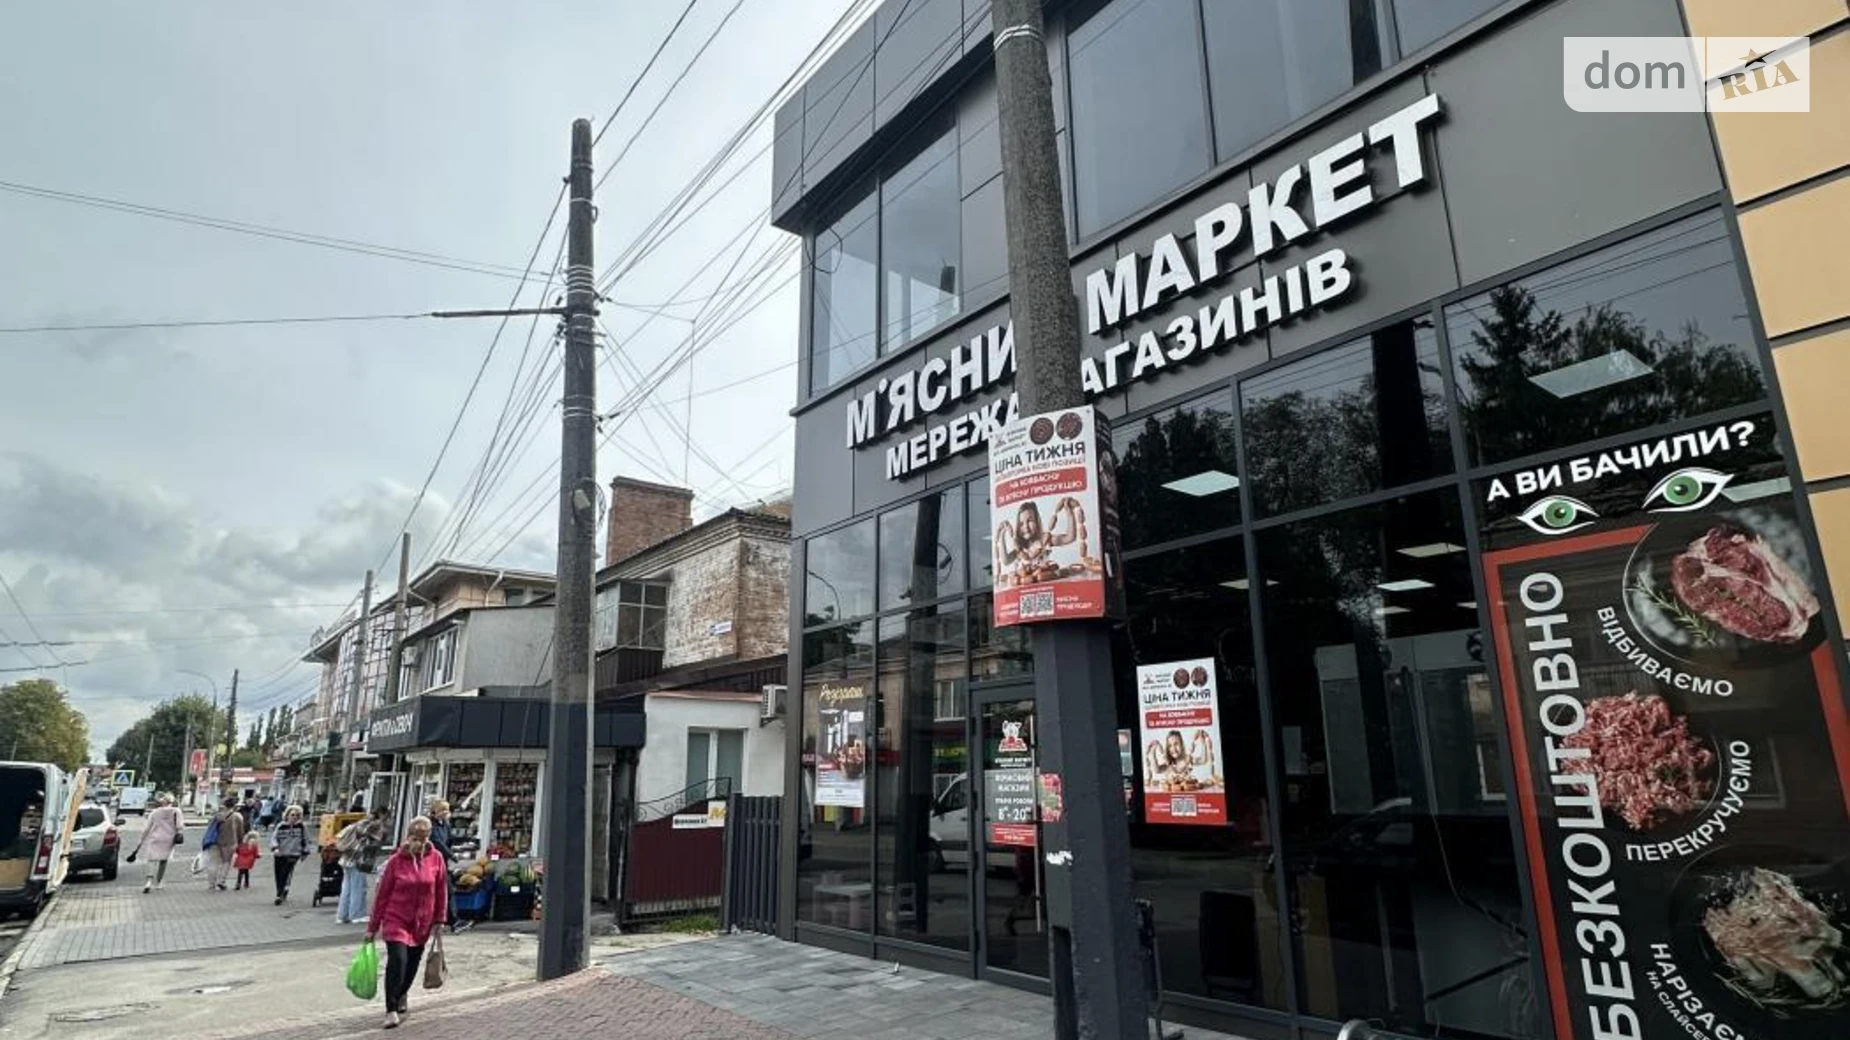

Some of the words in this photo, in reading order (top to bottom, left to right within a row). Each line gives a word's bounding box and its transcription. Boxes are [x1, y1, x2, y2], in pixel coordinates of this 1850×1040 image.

[846, 318, 1017, 449] М'ЯСНИ
[1085, 93, 1440, 335] МАРКЕТ
[1081, 247, 1352, 394] АГАЗИНІВ
[994, 454, 1022, 474] ЦІНА
[1025, 442, 1086, 463] ТИЖНЯ
[1487, 479, 1510, 501] А
[1516, 464, 1562, 495] ВИ
[1571, 420, 1755, 484] БАЧИЛИ?
[1597, 606, 1734, 697] ВІДБИВАЄМО
[1520, 572, 1643, 1040] БЕЗКОШТОВНО
[1626, 741, 1751, 861] ПЕРЕКРУЧУЄМО
[1646, 971, 1660, 990] НА
[1651, 944, 1745, 1040] НАРІЗАЄ
